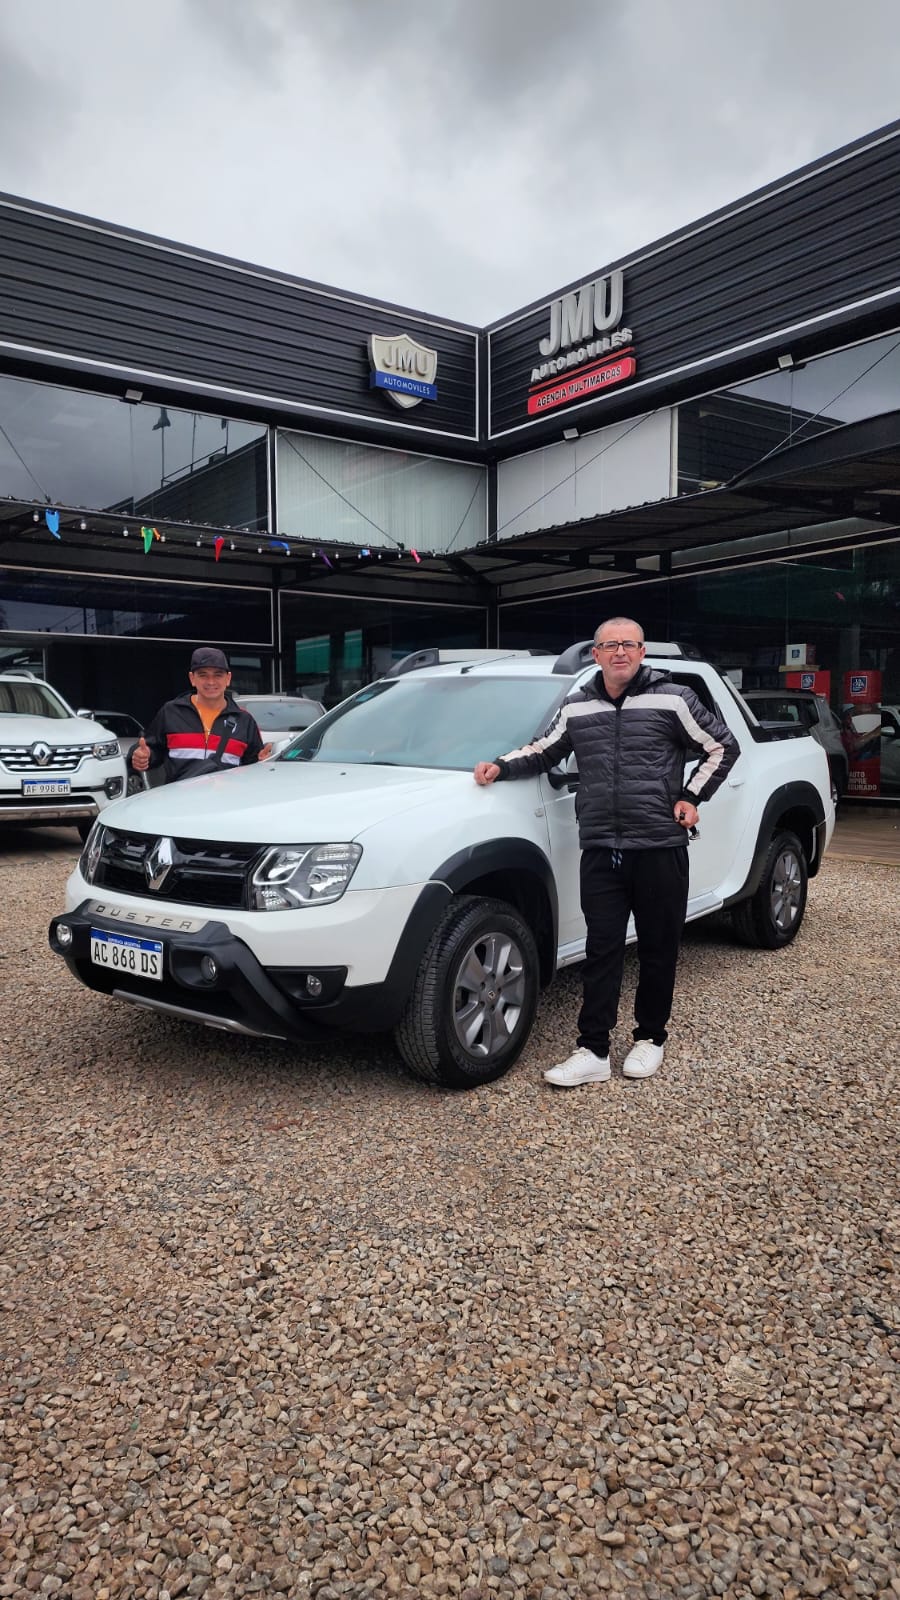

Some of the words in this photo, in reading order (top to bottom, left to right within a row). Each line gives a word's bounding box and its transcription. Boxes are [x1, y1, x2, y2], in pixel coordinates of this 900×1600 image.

[539, 271, 624, 356] JMU
[382, 345, 429, 376] JMU
[531, 328, 633, 382] AUTOMOVILES
[383, 377, 430, 395] AUTOMOVILES
[537, 384, 567, 407] AGENCIA
[568, 366, 621, 399] MULTIMARCAS
[26, 785, 36, 793] AF
[39, 785, 55, 793] 998
[58, 784, 69, 792] GH
[96, 905, 192, 929] DUSTER
[94, 942, 108, 963] AC
[112, 946, 135, 969] 868
[141, 952, 157, 975] DS
